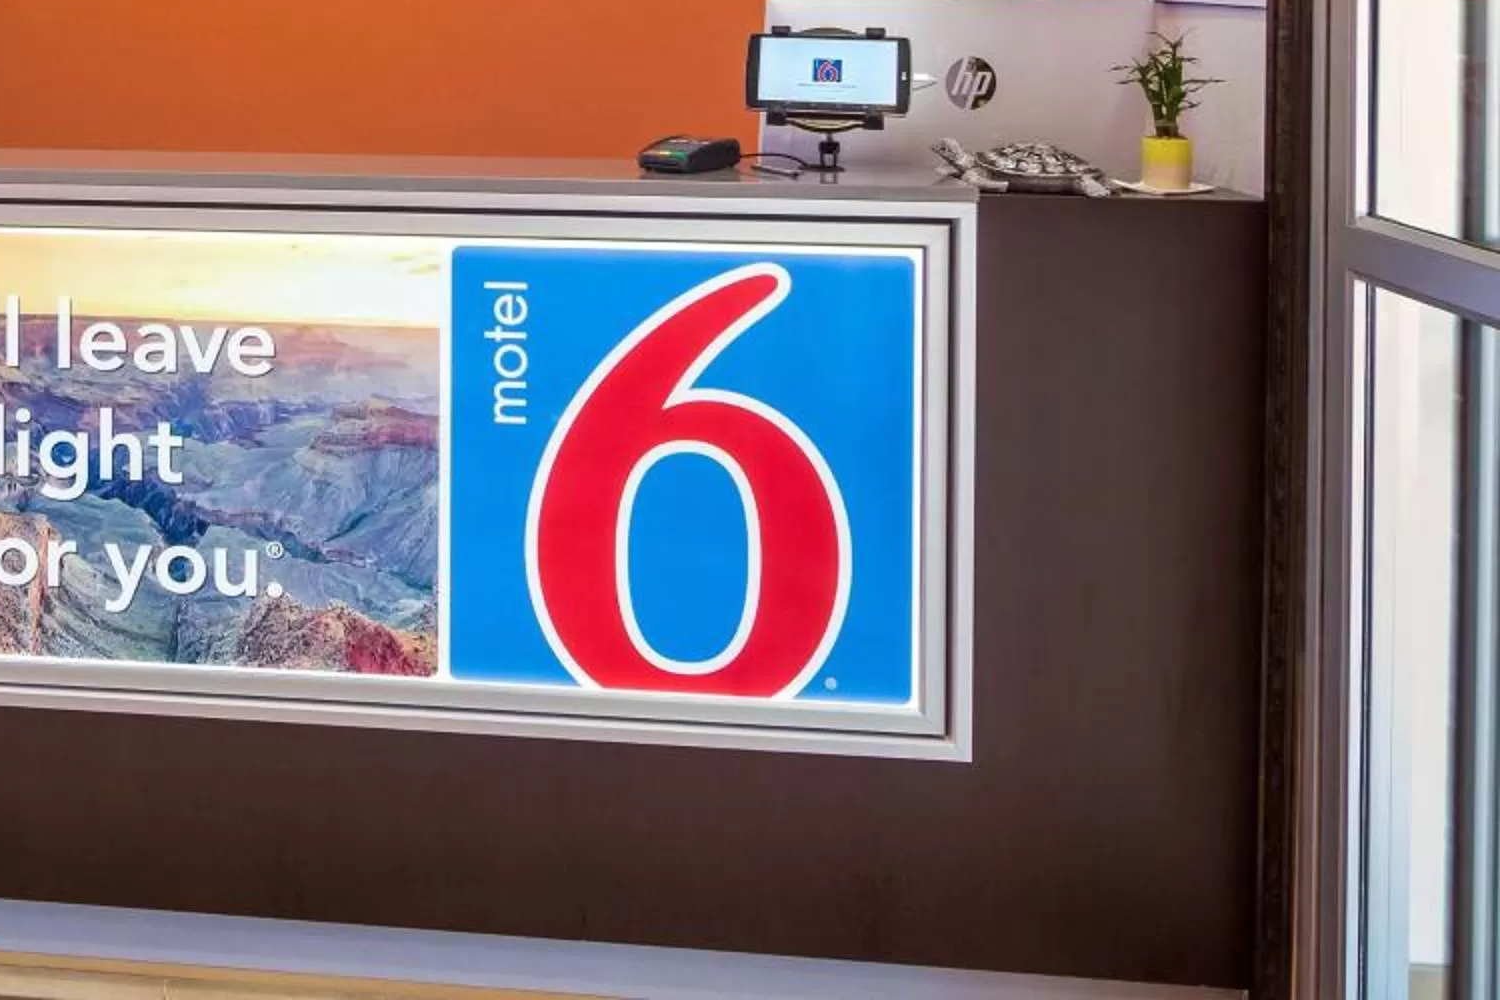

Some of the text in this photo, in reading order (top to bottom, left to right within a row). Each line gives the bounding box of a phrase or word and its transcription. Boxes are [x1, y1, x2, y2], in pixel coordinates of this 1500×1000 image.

[951, 57, 992, 110] hp
[58, 296, 276, 377] leave
[484, 262, 853, 699] motel 6
